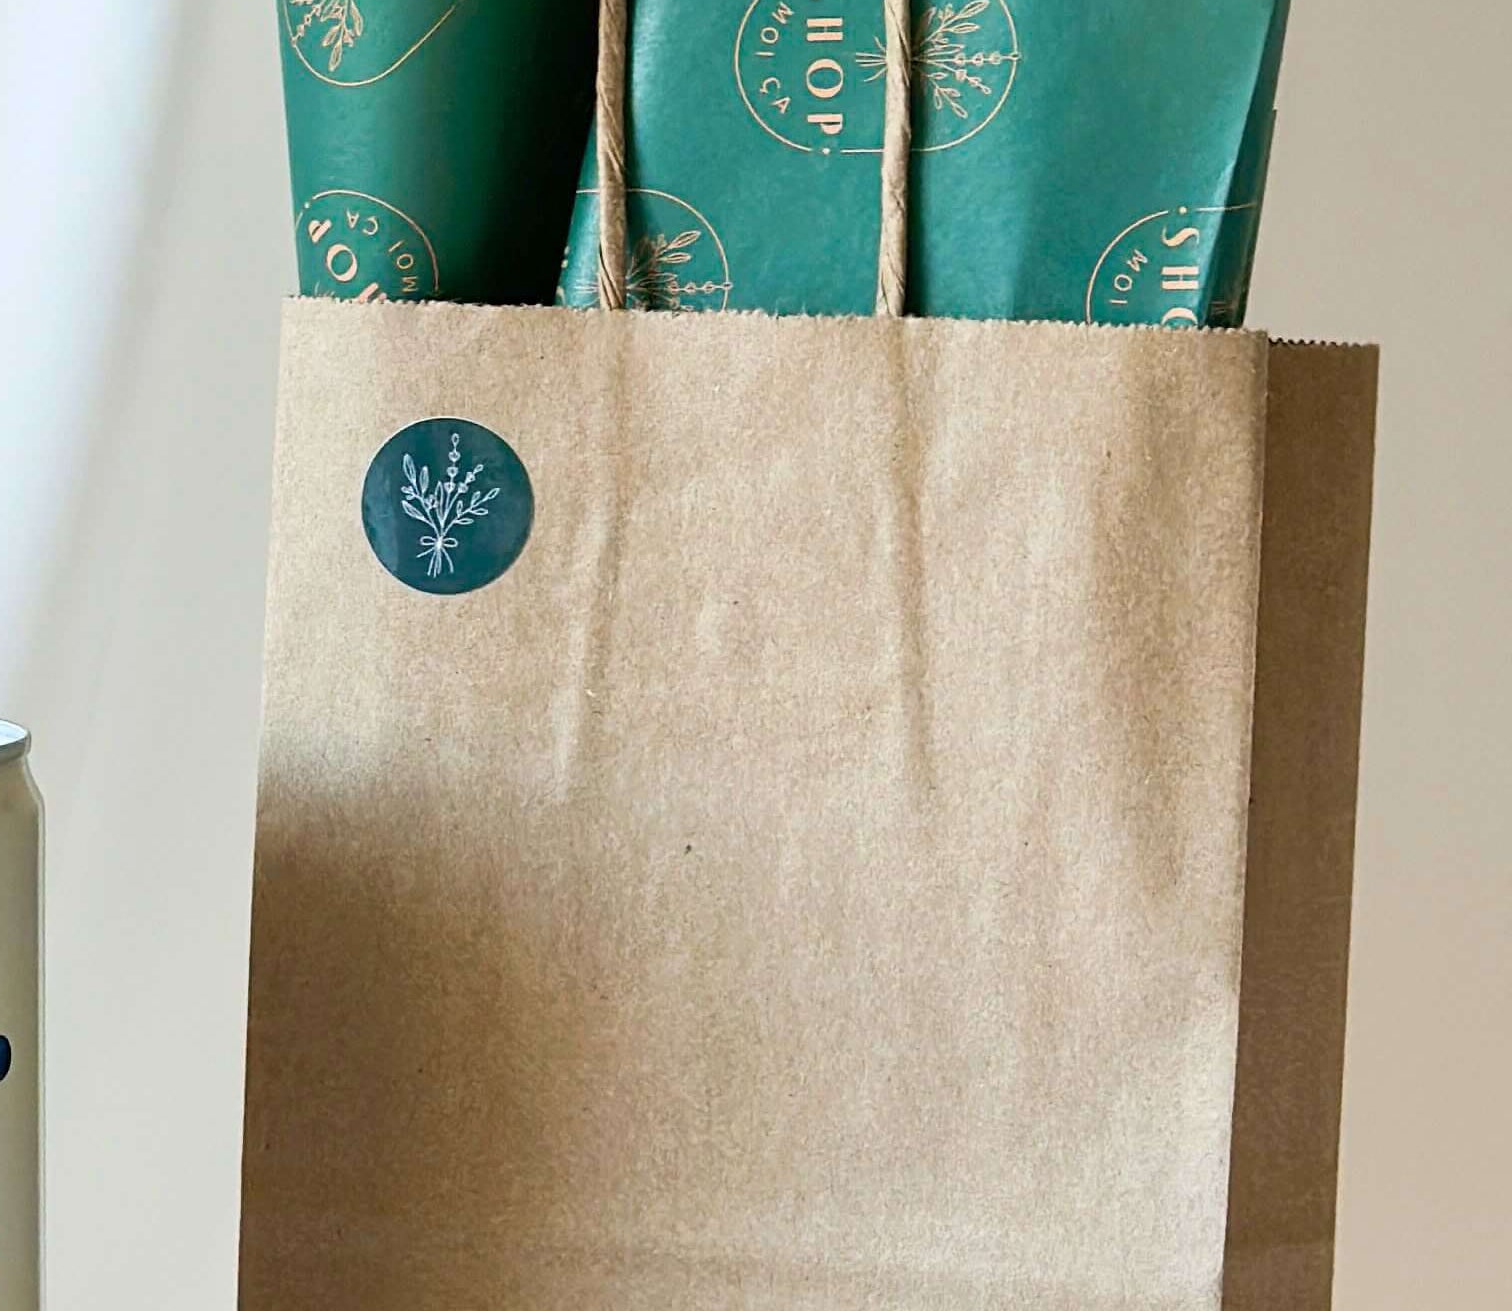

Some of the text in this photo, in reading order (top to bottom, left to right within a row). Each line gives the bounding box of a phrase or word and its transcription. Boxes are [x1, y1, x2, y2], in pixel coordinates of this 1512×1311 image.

[755, 1, 794, 114] MOI ÇA
[388, 239, 419, 292] MOI
[1108, 249, 1148, 304] MOI
